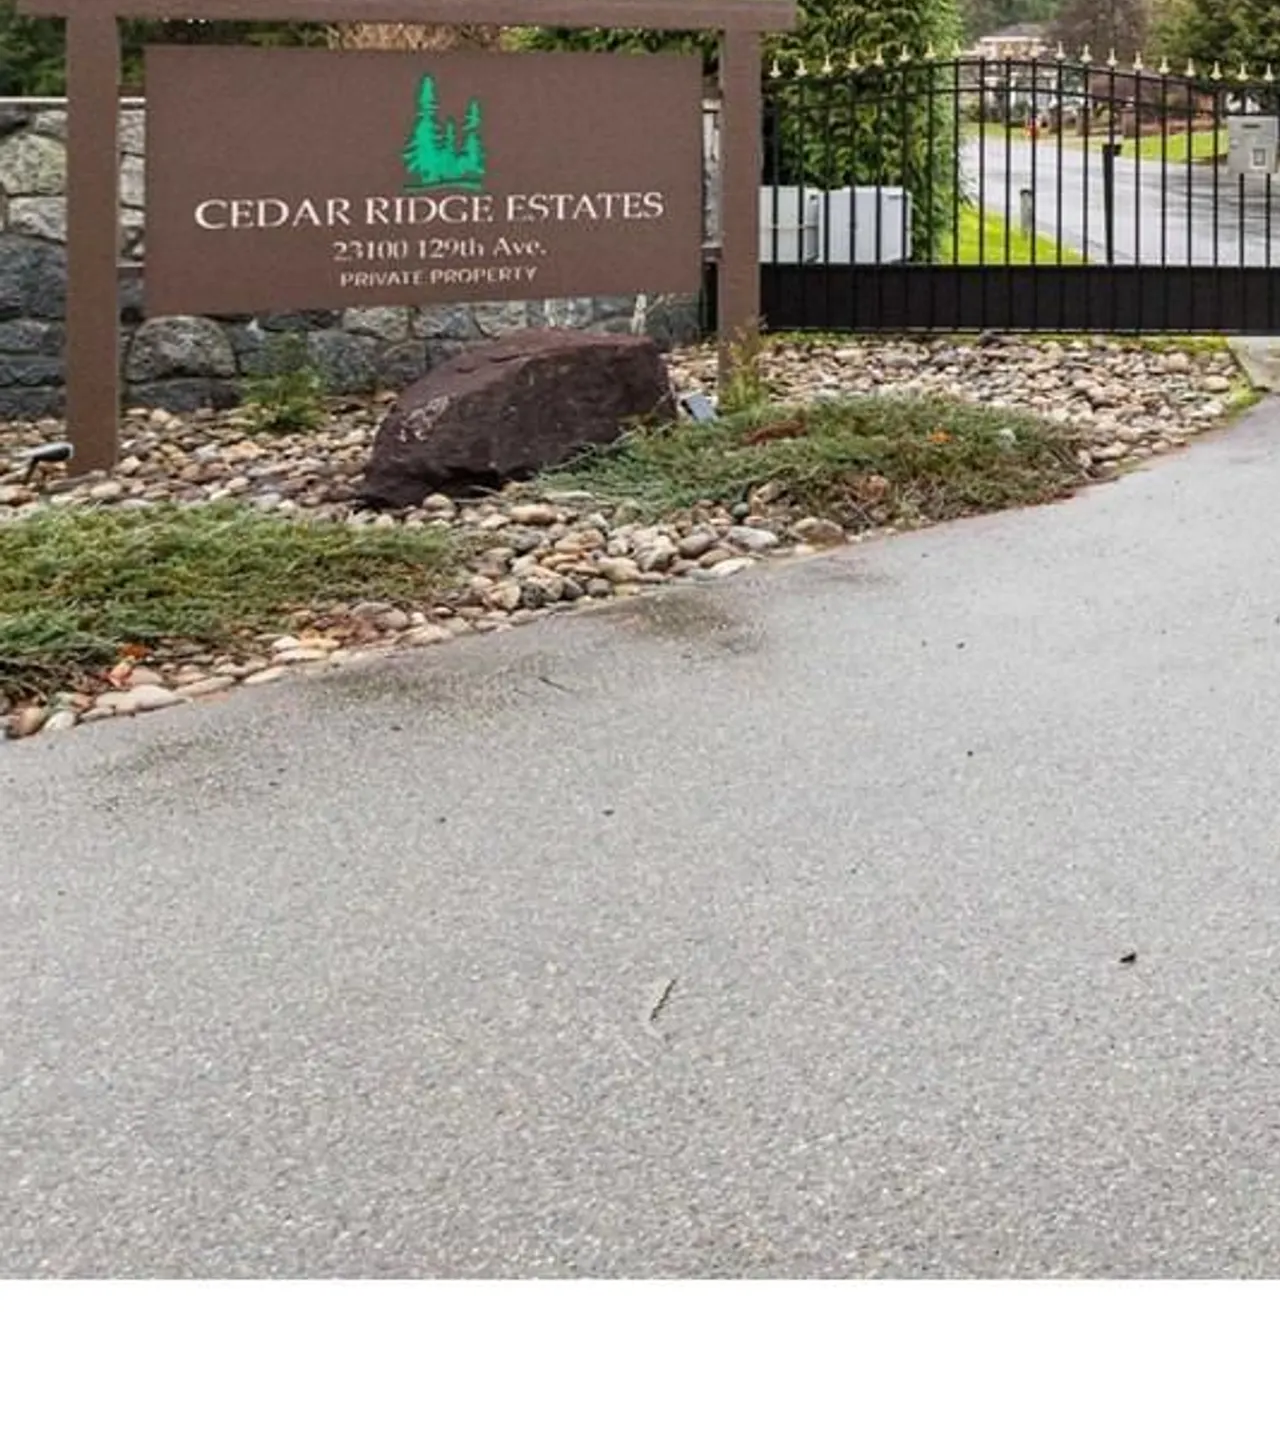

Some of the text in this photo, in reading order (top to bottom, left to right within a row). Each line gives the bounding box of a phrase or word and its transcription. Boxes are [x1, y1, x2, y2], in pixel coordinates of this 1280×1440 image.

[193, 191, 665, 230] CEDAR RIDGE ESTATES
[331, 236, 548, 262] 23100 129th Ave.
[340, 265, 538, 288] PRIVATE PROPERTY
